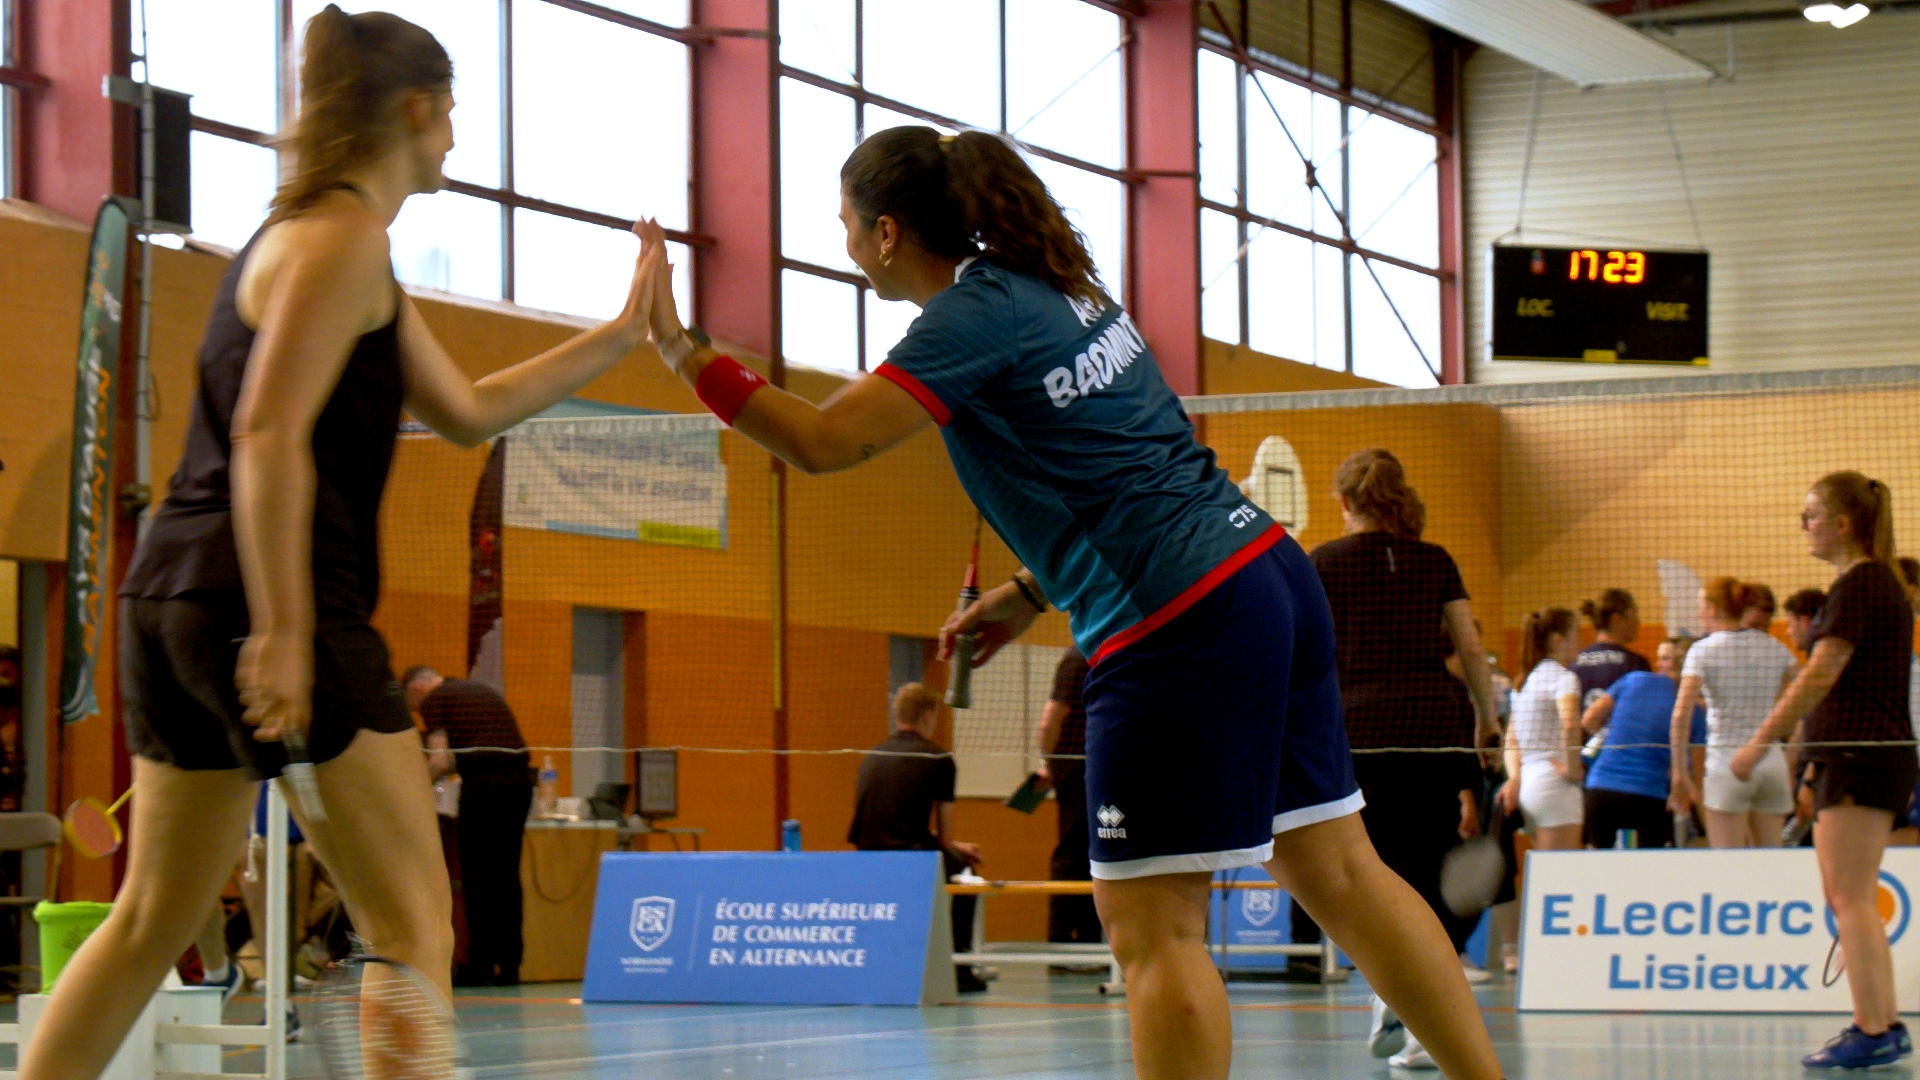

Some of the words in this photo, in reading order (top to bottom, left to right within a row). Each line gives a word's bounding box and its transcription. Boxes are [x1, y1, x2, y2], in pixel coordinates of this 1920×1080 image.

[715, 898, 776, 921] ÉCOLE
[780, 898, 897, 921] SUPÉRIEURE
[1541, 894, 1814, 936] E.Leclerc
[712, 925, 739, 943] DE
[744, 925, 857, 944] COMMERCE
[709, 948, 735, 965] EN
[740, 948, 867, 967] ALTERNANCE
[1609, 954, 1810, 991] Lisieux
